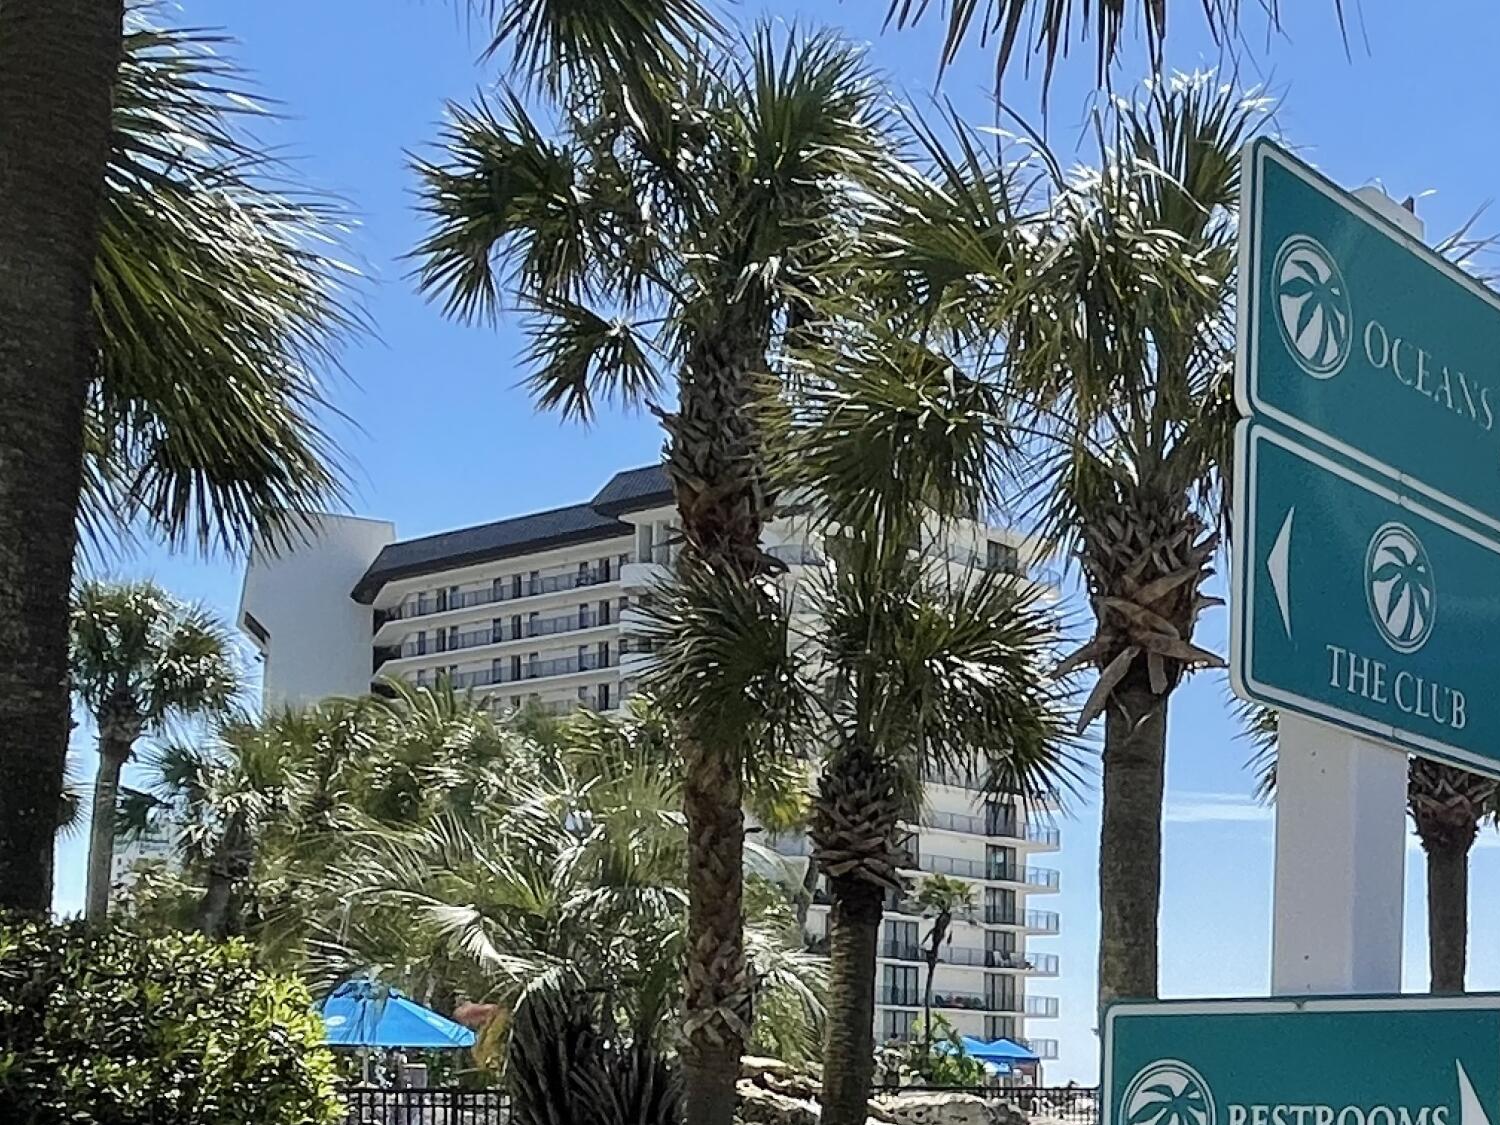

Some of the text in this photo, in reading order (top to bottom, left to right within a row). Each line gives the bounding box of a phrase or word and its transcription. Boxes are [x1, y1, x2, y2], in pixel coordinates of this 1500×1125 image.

[1363, 319, 1493, 432] OCEANS
[1326, 644, 1466, 729] THE CLUB
